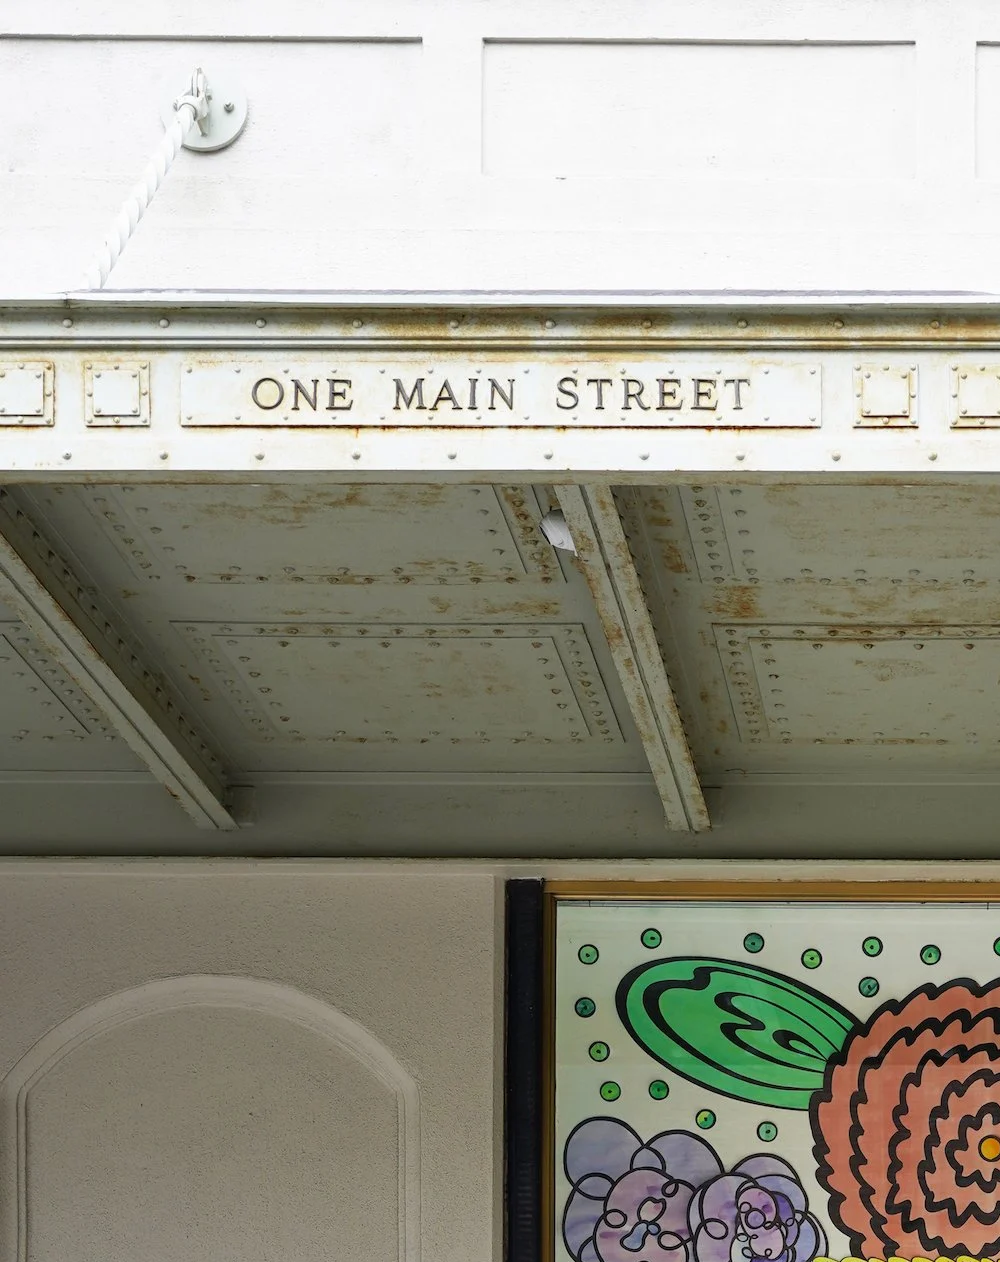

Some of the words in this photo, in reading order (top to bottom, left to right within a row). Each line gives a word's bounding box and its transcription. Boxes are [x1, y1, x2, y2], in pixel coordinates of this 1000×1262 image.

[251, 376, 355, 412] ONE
[392, 377, 516, 412] MAIN
[555, 376, 752, 411] STREET
